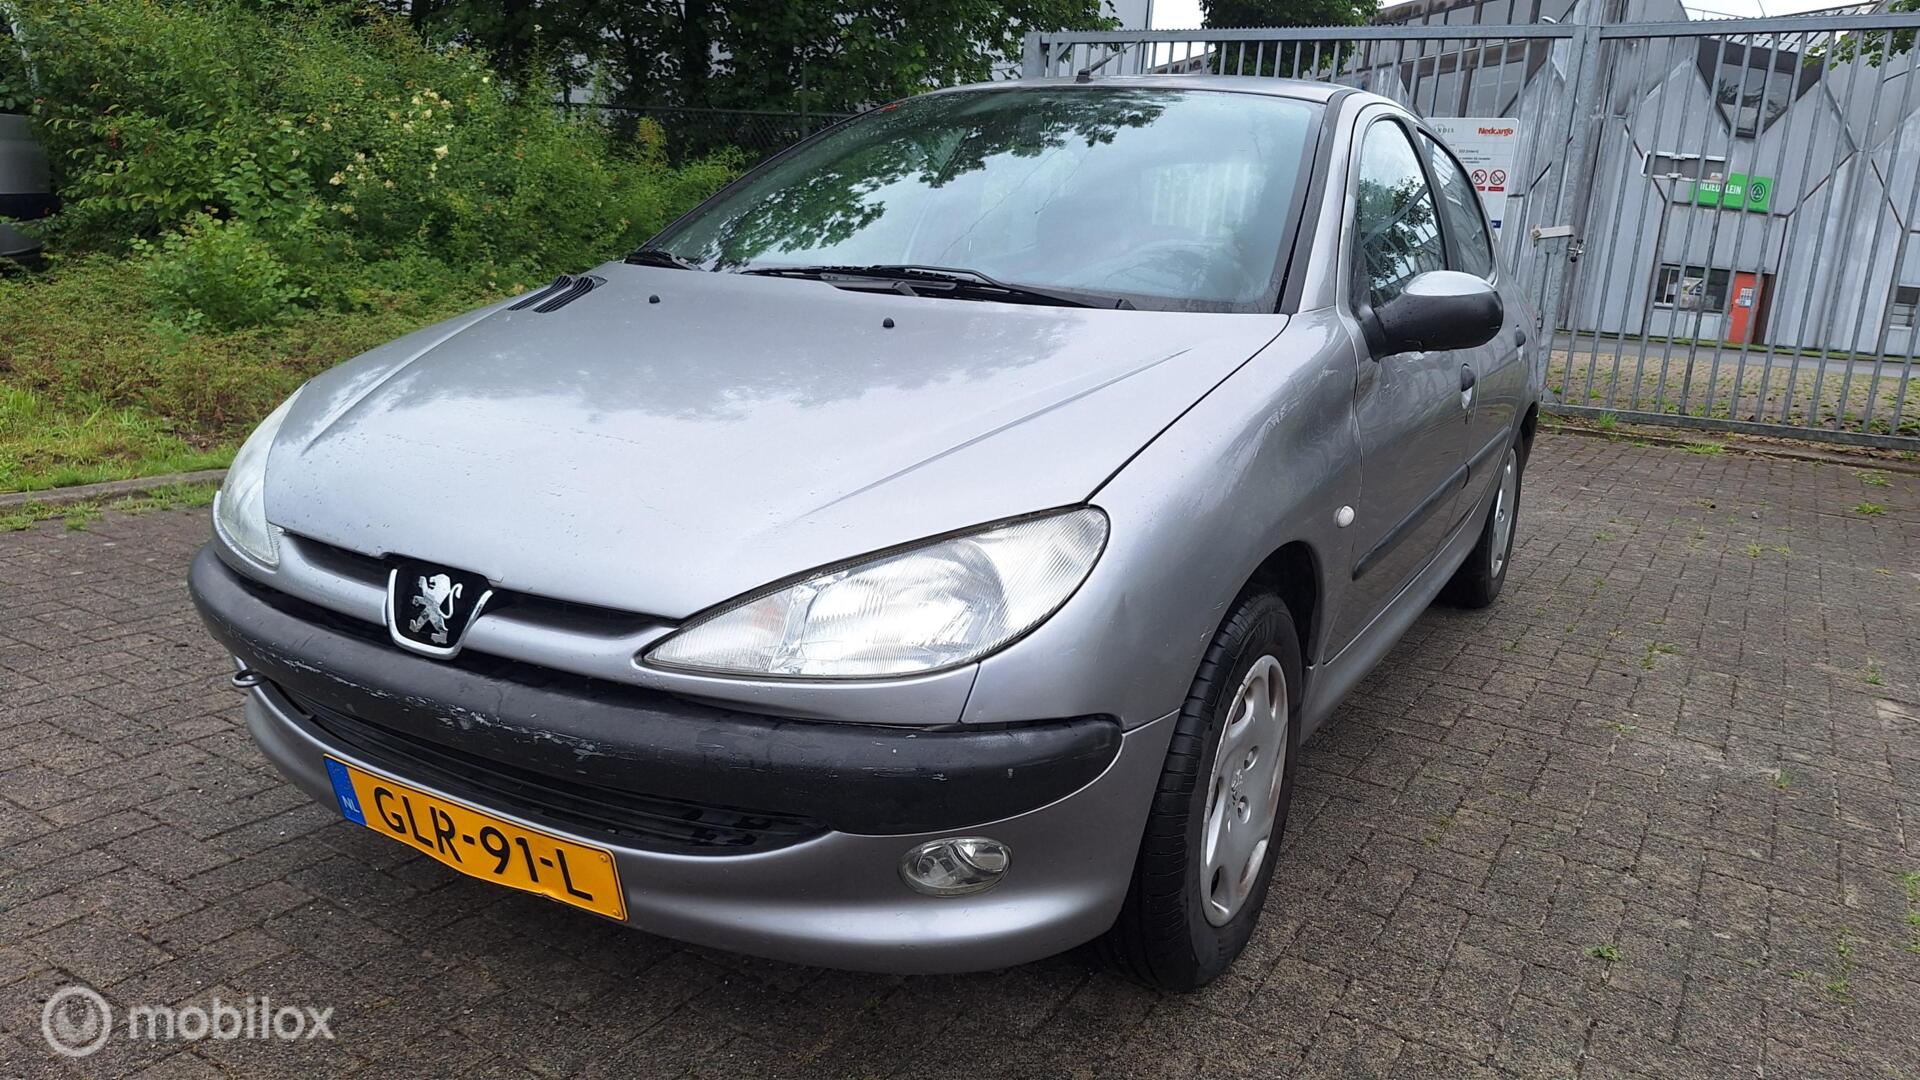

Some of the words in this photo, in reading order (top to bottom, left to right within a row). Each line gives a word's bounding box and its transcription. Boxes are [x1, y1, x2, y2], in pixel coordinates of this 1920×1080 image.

[1478, 127, 1513, 136] Nedcargo
[1699, 182, 1742, 195] ILIEULEIN
[341, 795, 360, 814] NL
[374, 786, 594, 902] GLR-91-L
